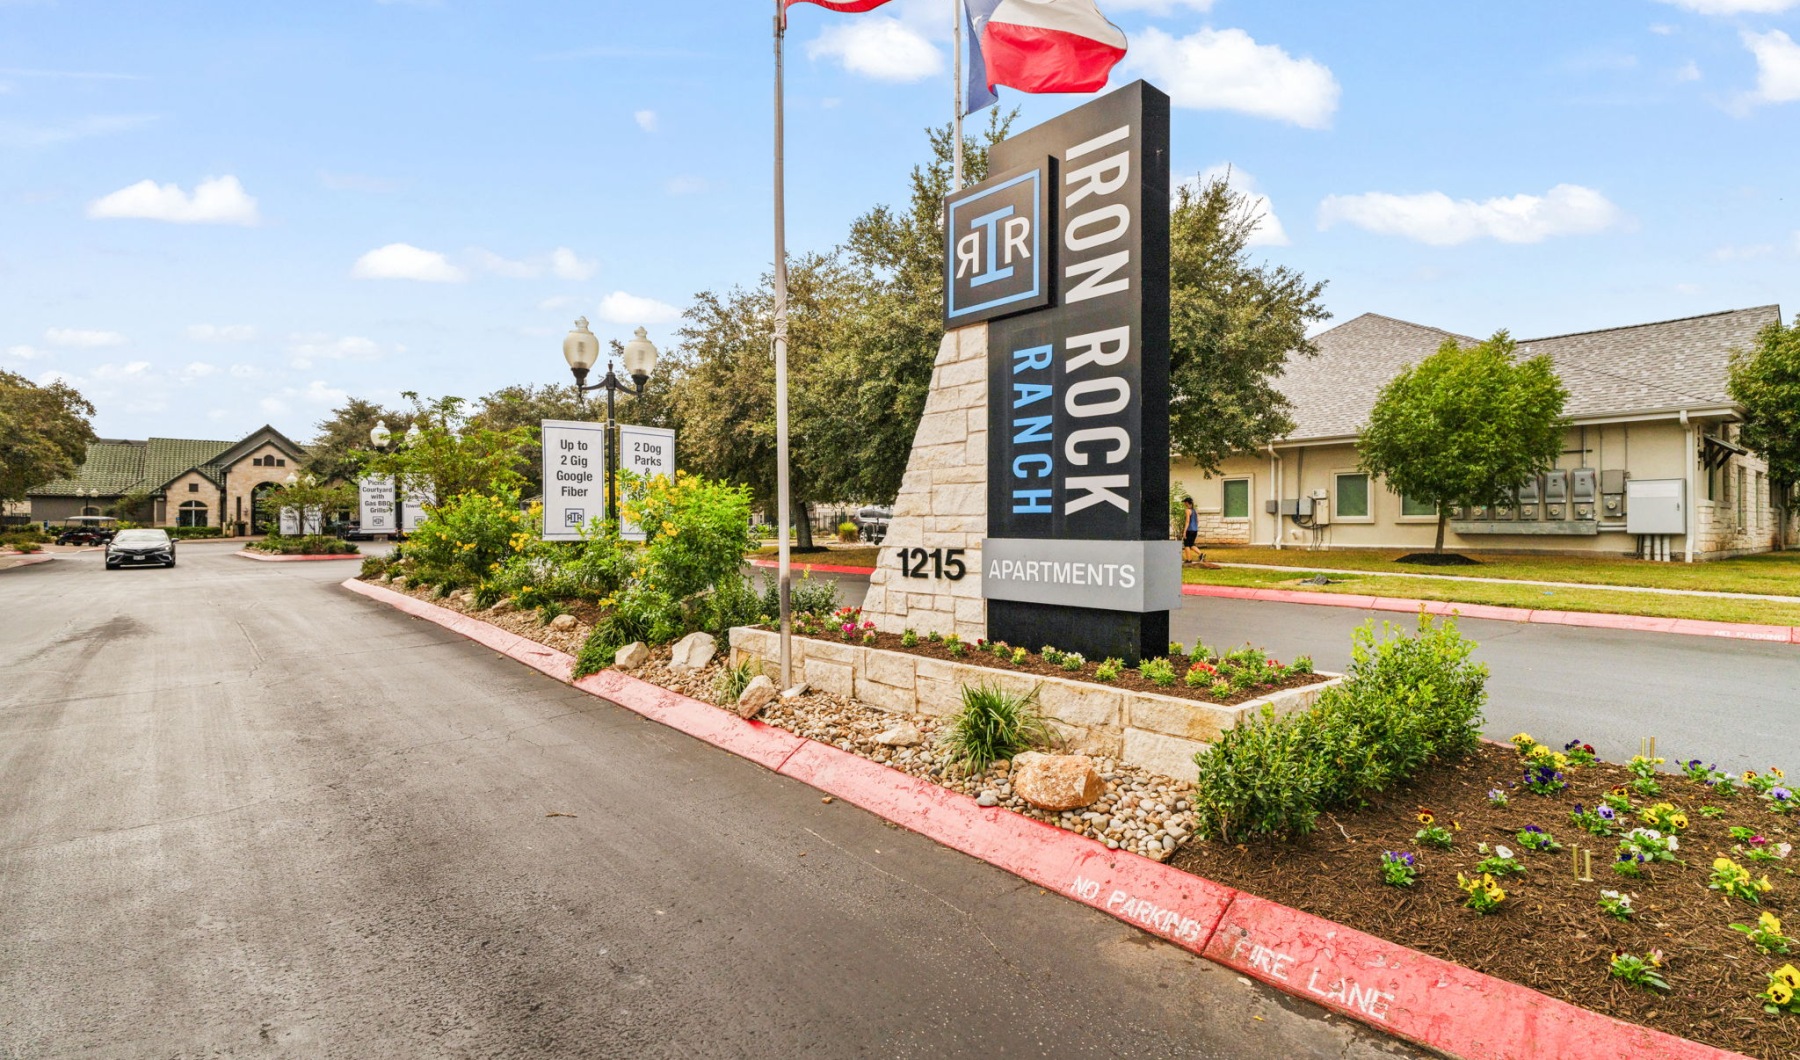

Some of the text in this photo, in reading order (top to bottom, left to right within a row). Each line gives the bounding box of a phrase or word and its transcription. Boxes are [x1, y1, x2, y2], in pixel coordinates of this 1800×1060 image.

[1064, 124, 1131, 516] IRON ROCK
[1012, 343, 1053, 515] RANCH
[560, 439, 588, 452] Up to
[634, 442, 662, 455] 2 Dog
[560, 454, 588, 468] 2 Gig
[634, 455, 662, 467] Parks
[556, 470, 593, 483] Google
[561, 486, 588, 497] Fiber
[896, 548, 967, 581] 1215
[988, 558, 1136, 589] APARTMENTS
[1070, 875, 1396, 1020] NO PARKING FIRE LANE
